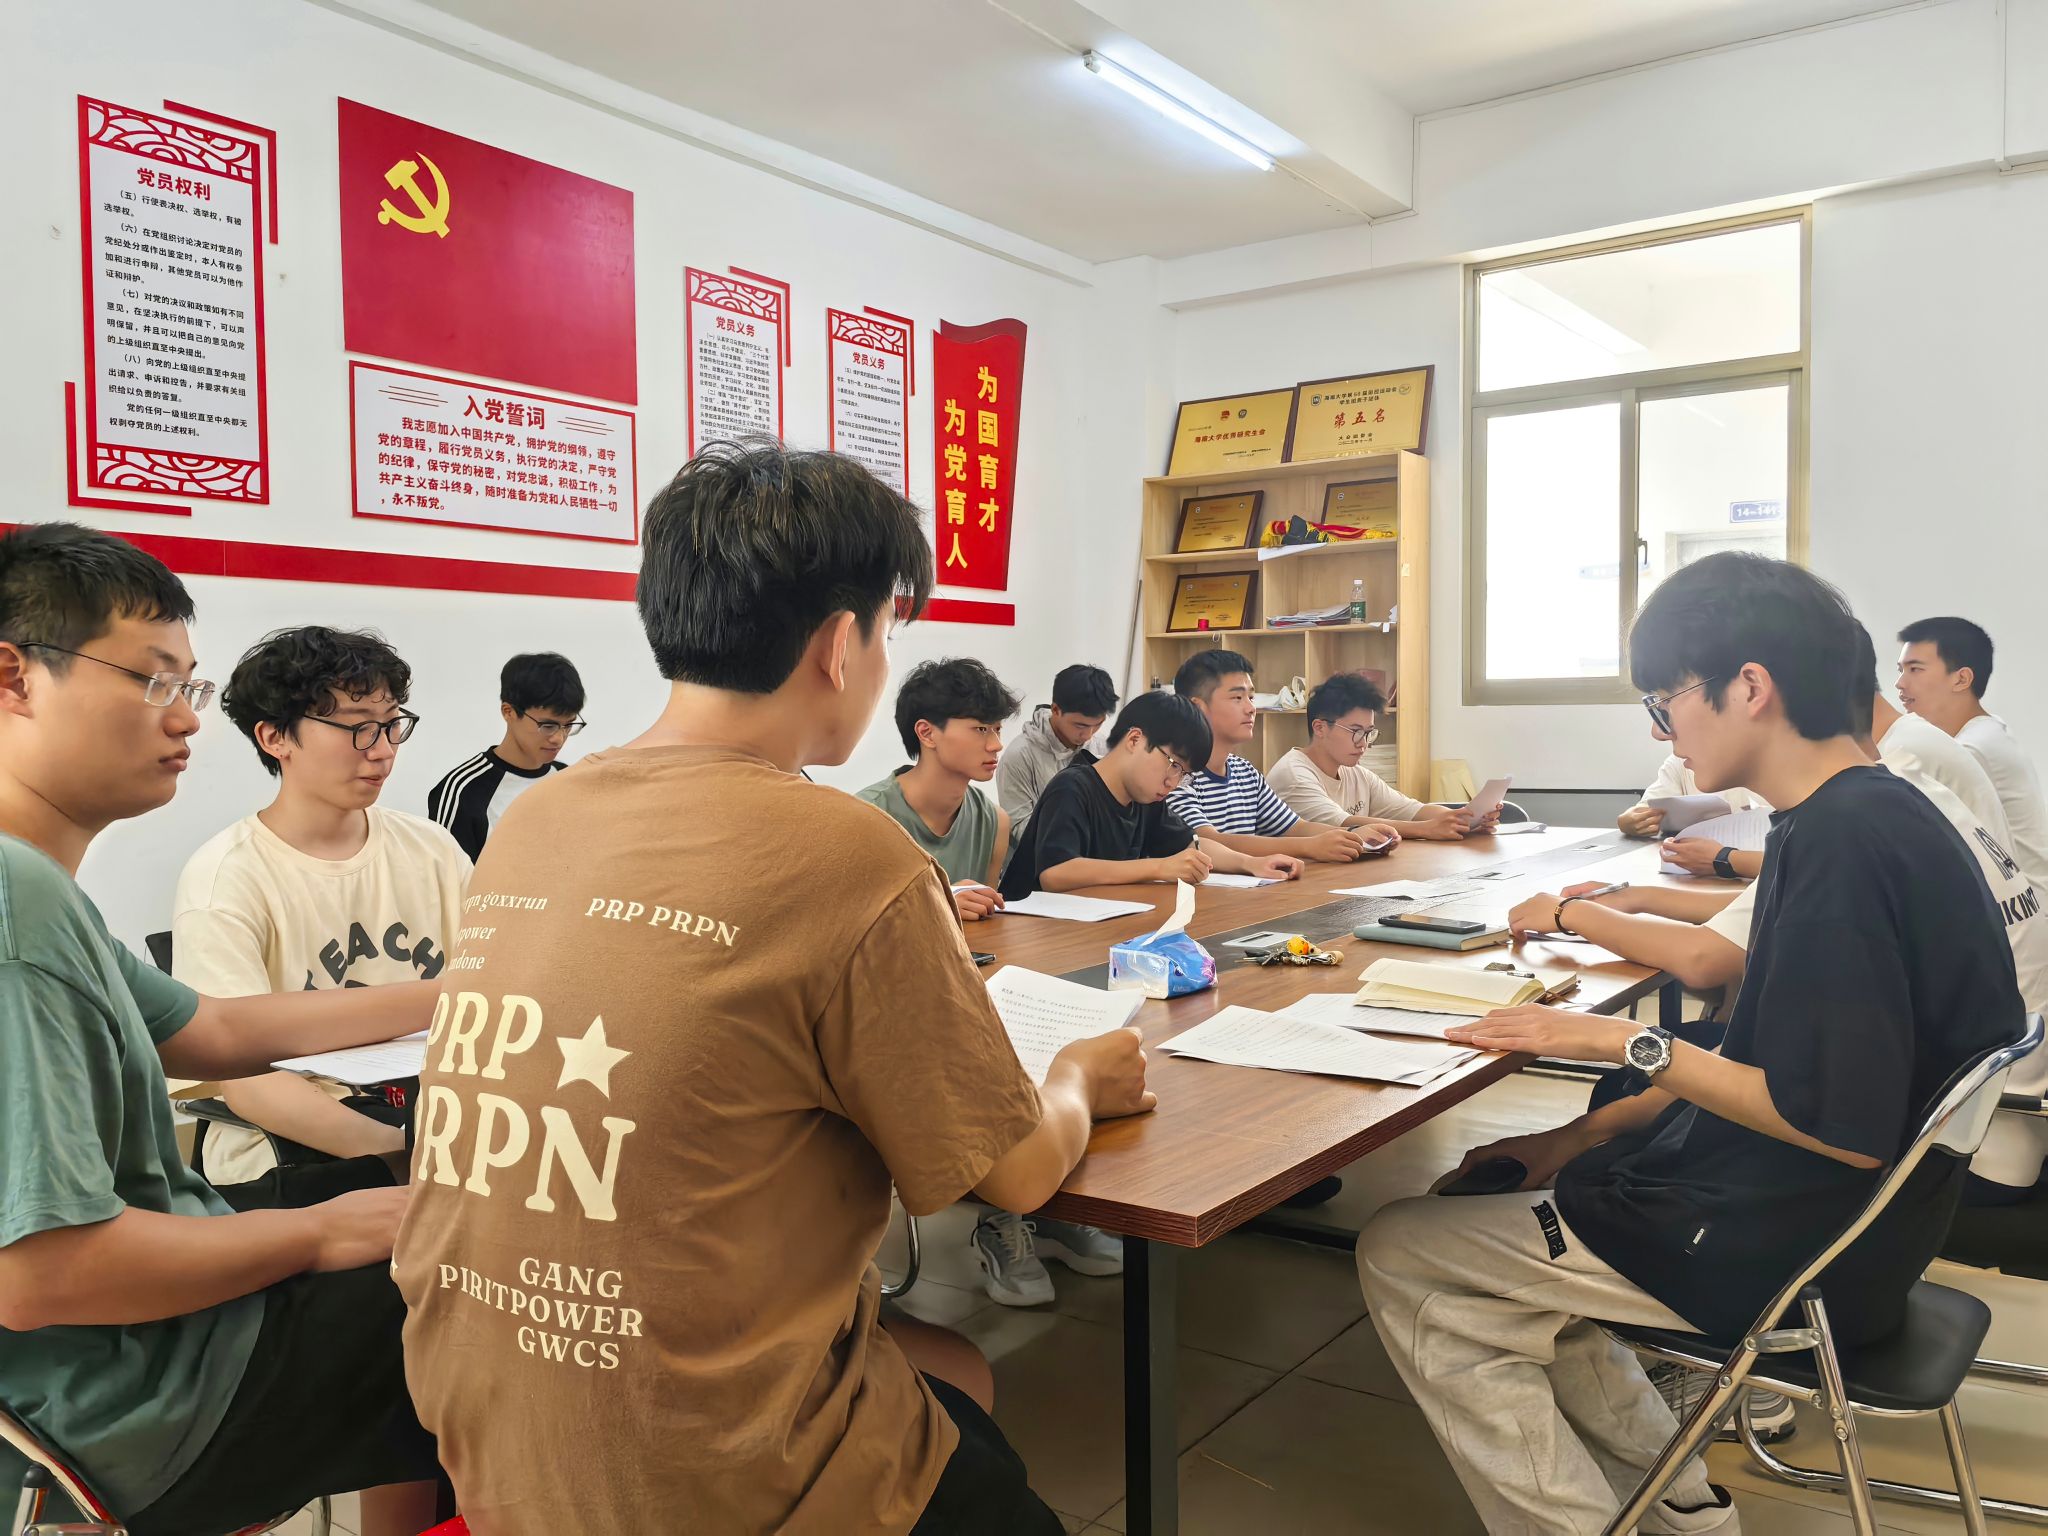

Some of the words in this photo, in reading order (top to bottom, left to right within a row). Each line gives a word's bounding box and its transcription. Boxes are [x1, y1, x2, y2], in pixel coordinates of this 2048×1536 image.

[137, 167, 210, 201] 党员权利
[103, 202, 135, 218] 选举权。
[106, 268, 145, 284] 证和辩护。
[716, 315, 755, 337] 党员义务
[107, 335, 206, 359] 的上级组织直至中央提出。
[852, 351, 886, 371] 党员义务
[109, 417, 200, 437] 权剥夺党员的上述权利。
[126, 403, 248, 428] 党的任何一级组织直至中央都无
[463, 394, 546, 430] 入党誓词
[1334, 408, 1385, 429] 第五名
[378, 433, 617, 479] 党的章程，履行党员义务，执行党的决定，严守党
[401, 416, 616, 461] 我志愿加入中国共产党，拥护党的纲领，遵守
[977, 366, 1000, 533] 为国育才
[378, 452, 617, 496] 的纪律，保守党的秘密，对党忠诚，积极工作，为
[379, 471, 618, 513] 共产主义奋斗终身，随时准备为党和人民牺牲一切
[944, 398, 969, 569] 为党育人
[585, 897, 645, 924] PRP
[649, 904, 740, 947] PRPN
[414, 1085, 636, 1222] RPN
[518, 1256, 623, 1299] GANG
[517, 1325, 620, 1370] GWCS
